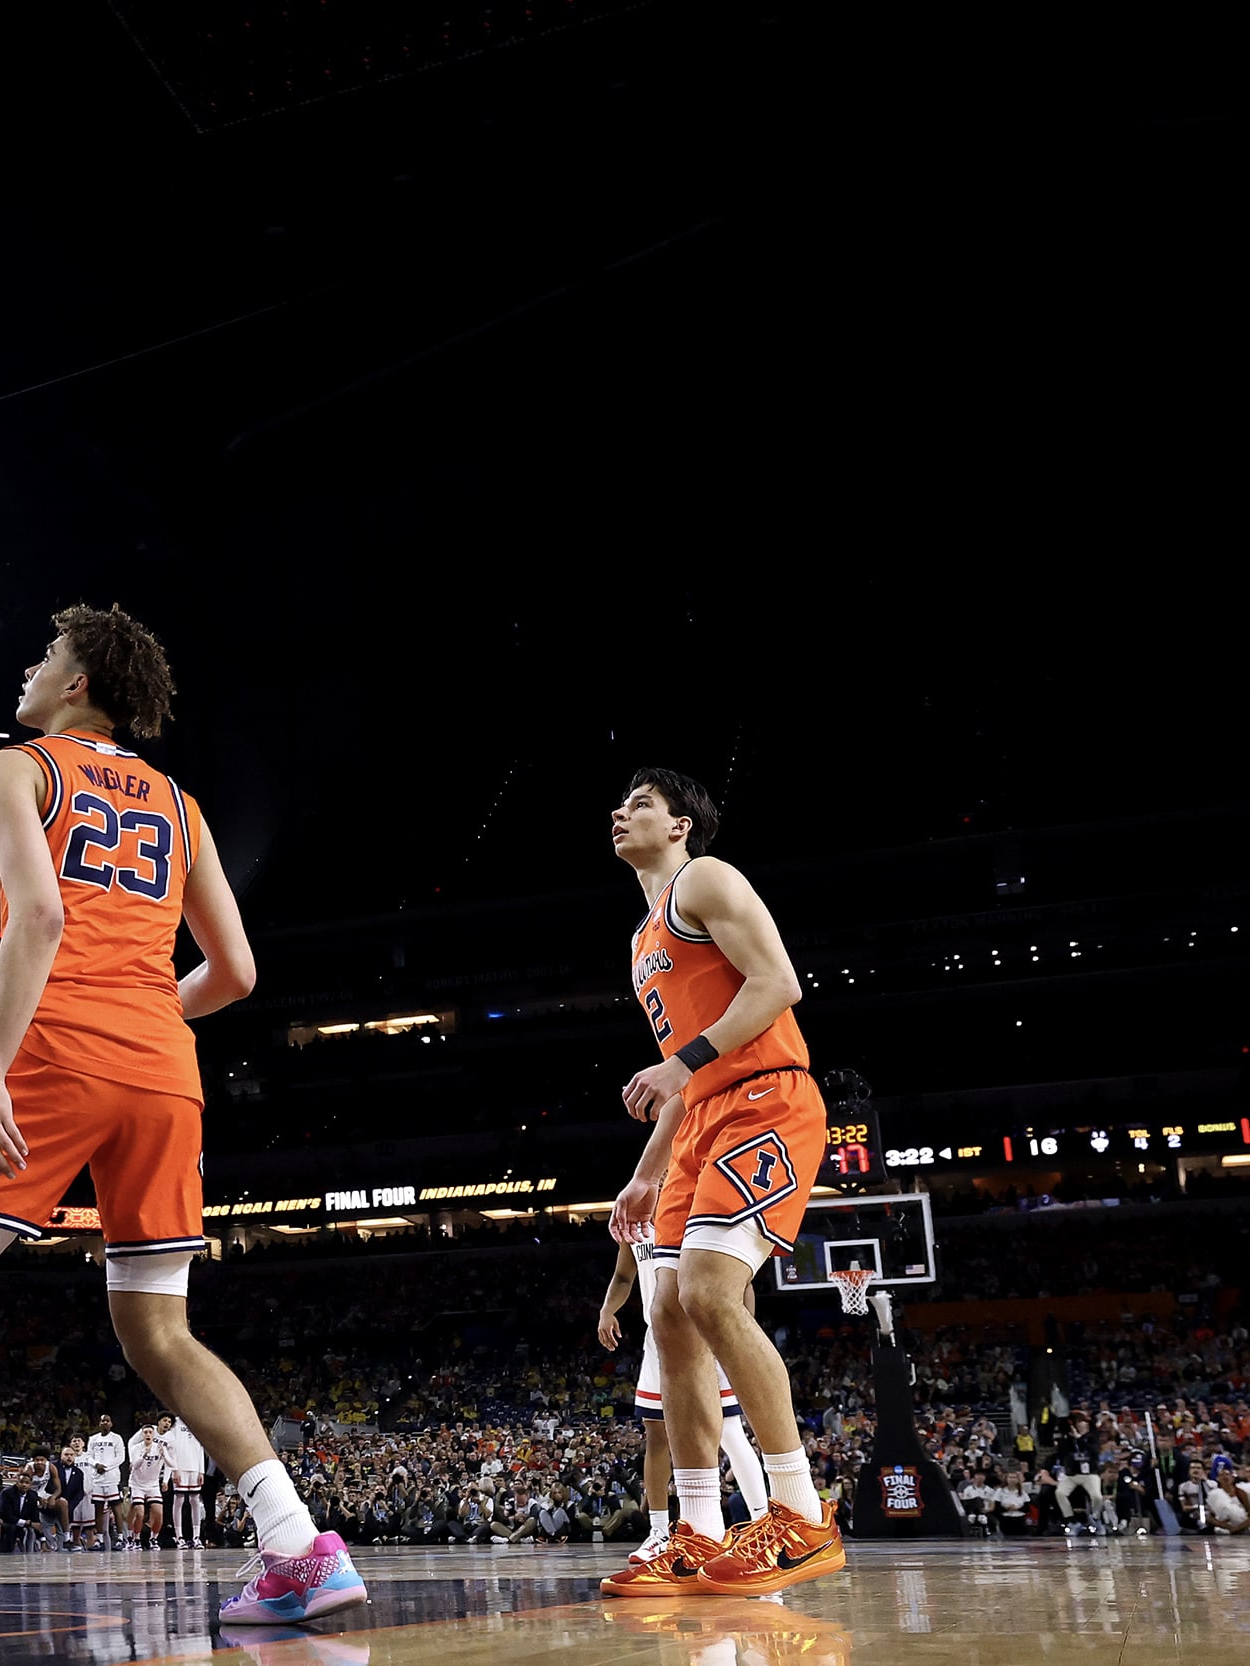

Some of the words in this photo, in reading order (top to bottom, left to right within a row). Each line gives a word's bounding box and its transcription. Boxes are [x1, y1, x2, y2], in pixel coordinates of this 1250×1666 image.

[77, 764, 151, 802] WAGLER
[60, 790, 174, 902] 23
[645, 986, 674, 1043] 2
[1029, 1138, 1058, 1157] 16
[1167, 1135, 1182, 1148] 2
[202, 1205, 230, 1217] 026
[231, 1201, 273, 1215] NCAA
[274, 1198, 322, 1212] MEN'S
[325, 1189, 370, 1212] FINAL
[372, 1185, 416, 1208] FOUR
[419, 1179, 535, 1201] INDIANAPOLIS,
[536, 1178, 557, 1192] IN
[883, 1475, 916, 1487] FINAL
[887, 1498, 918, 1509] FOUR
